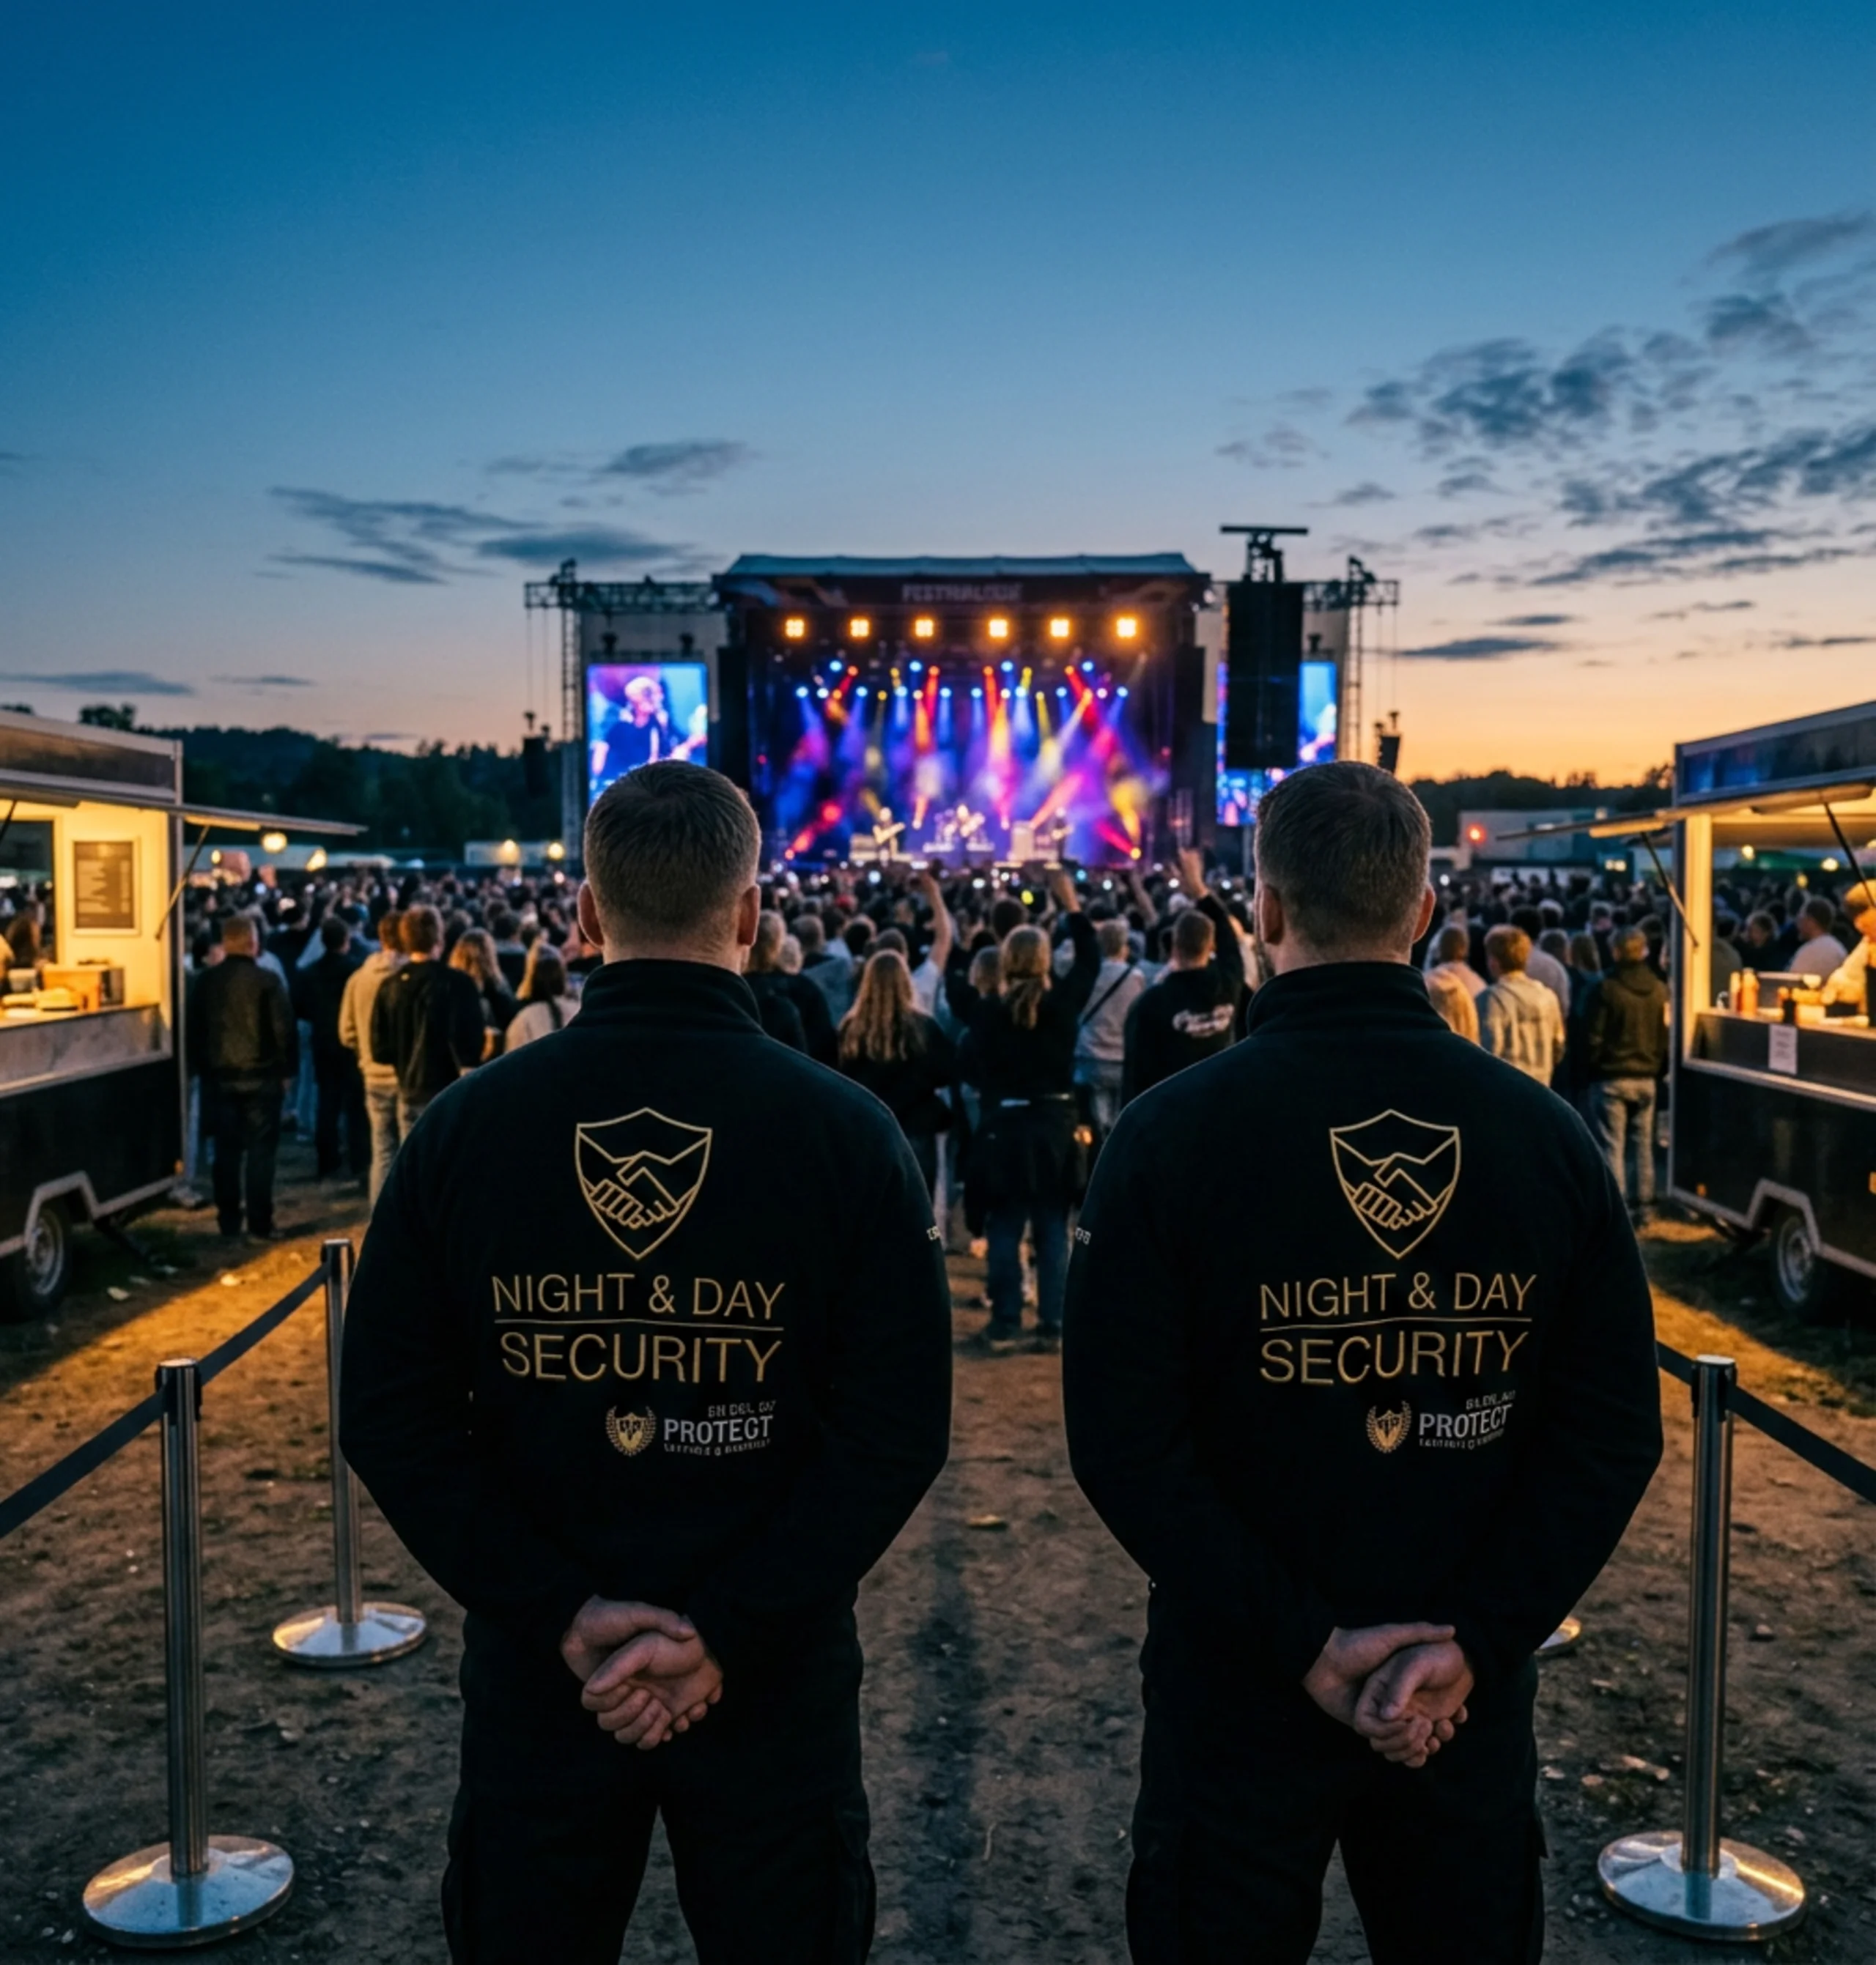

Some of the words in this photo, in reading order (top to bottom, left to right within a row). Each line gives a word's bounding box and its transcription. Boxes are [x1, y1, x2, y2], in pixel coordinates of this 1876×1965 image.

[492, 1273, 635, 1312] NIGHT
[649, 1274, 676, 1314] &
[693, 1277, 785, 1320] DAY
[1260, 1273, 1397, 1320] NIGHT
[1408, 1271, 1436, 1309] &
[1454, 1272, 1537, 1311] DAY
[501, 1331, 783, 1383] SECURITY
[1260, 1330, 1528, 1385] SECURITY
[663, 1415, 774, 1444] PROTECT
[1419, 1403, 1513, 1438] PROTECT
